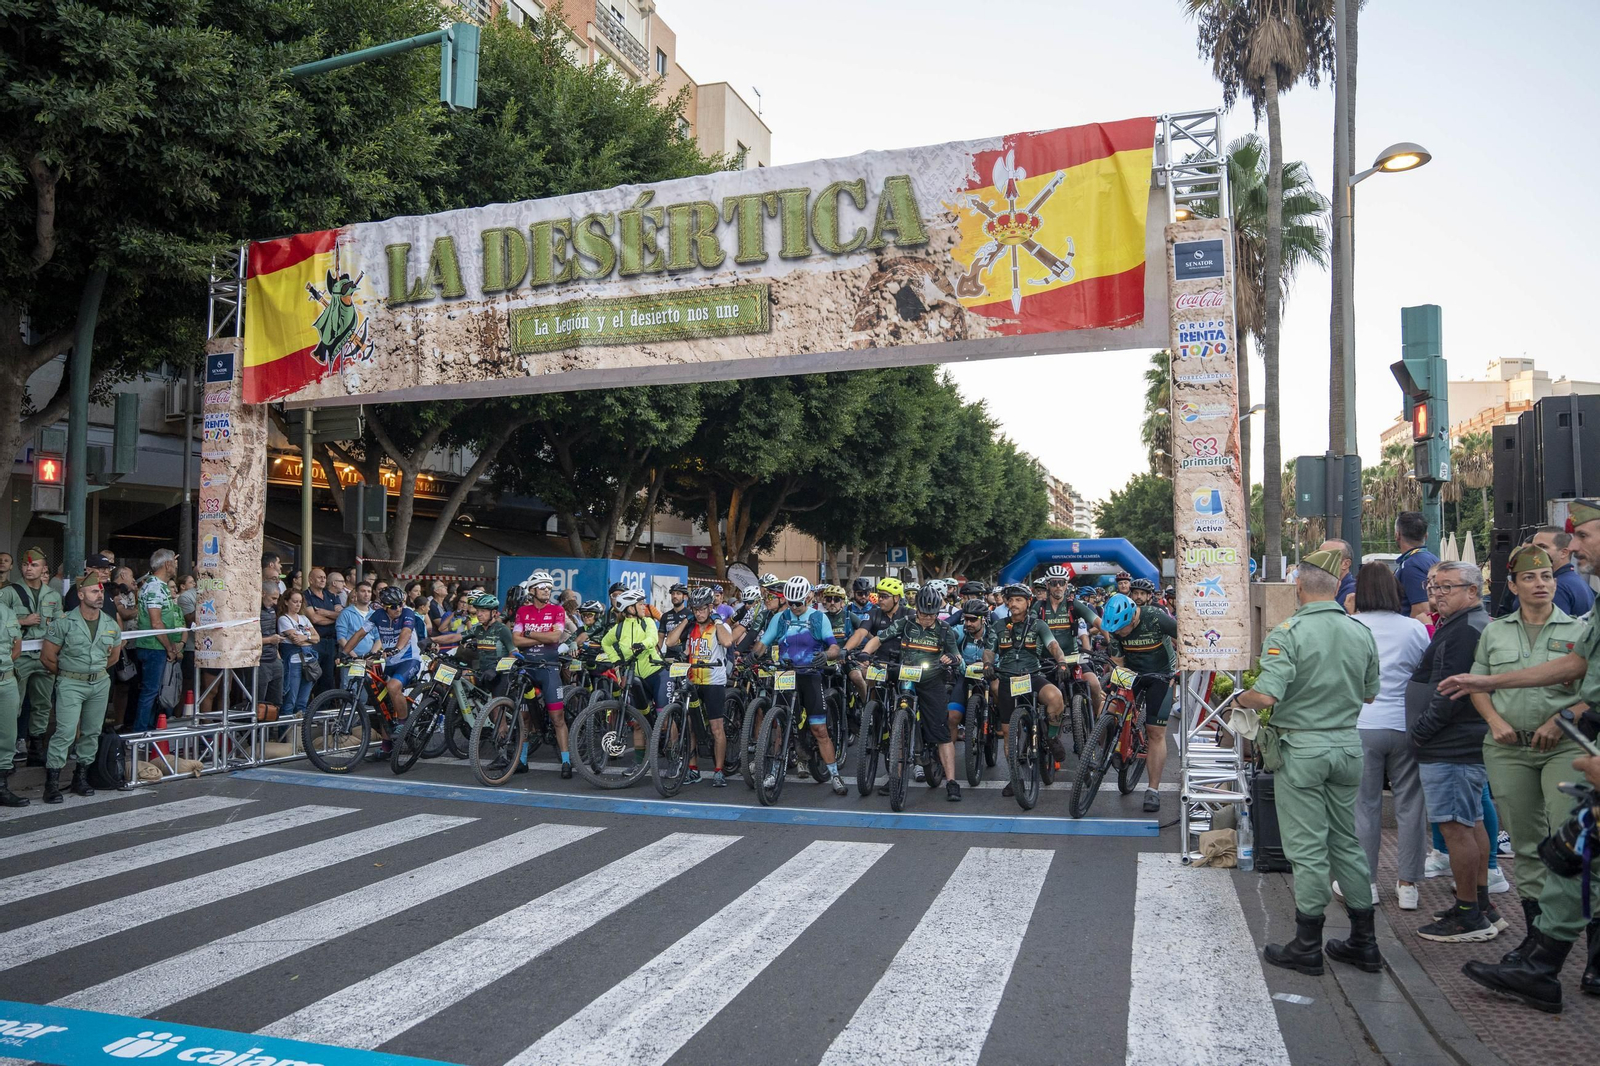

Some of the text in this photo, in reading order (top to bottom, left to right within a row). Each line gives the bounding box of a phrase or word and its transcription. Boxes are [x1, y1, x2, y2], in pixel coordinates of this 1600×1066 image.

[385, 174, 930, 306] LA DESÉRTICA
[1185, 260, 1213, 268] SENATOR
[1176, 291, 1225, 309] Coca-Cola
[534, 304, 739, 335] La Legión y el desierto nos une
[1179, 320, 1224, 330] GRUPO
[1180, 330, 1226, 342] RENTA
[1180, 342, 1227, 357] TODO
[205, 420, 229, 428] RENTA
[205, 429, 229, 440] TODO
[1183, 457, 1232, 469] primaflor
[285, 464, 359, 483] AUOMVIL
[200, 512, 226, 520] primaflor
[891, 549, 903, 562] P
